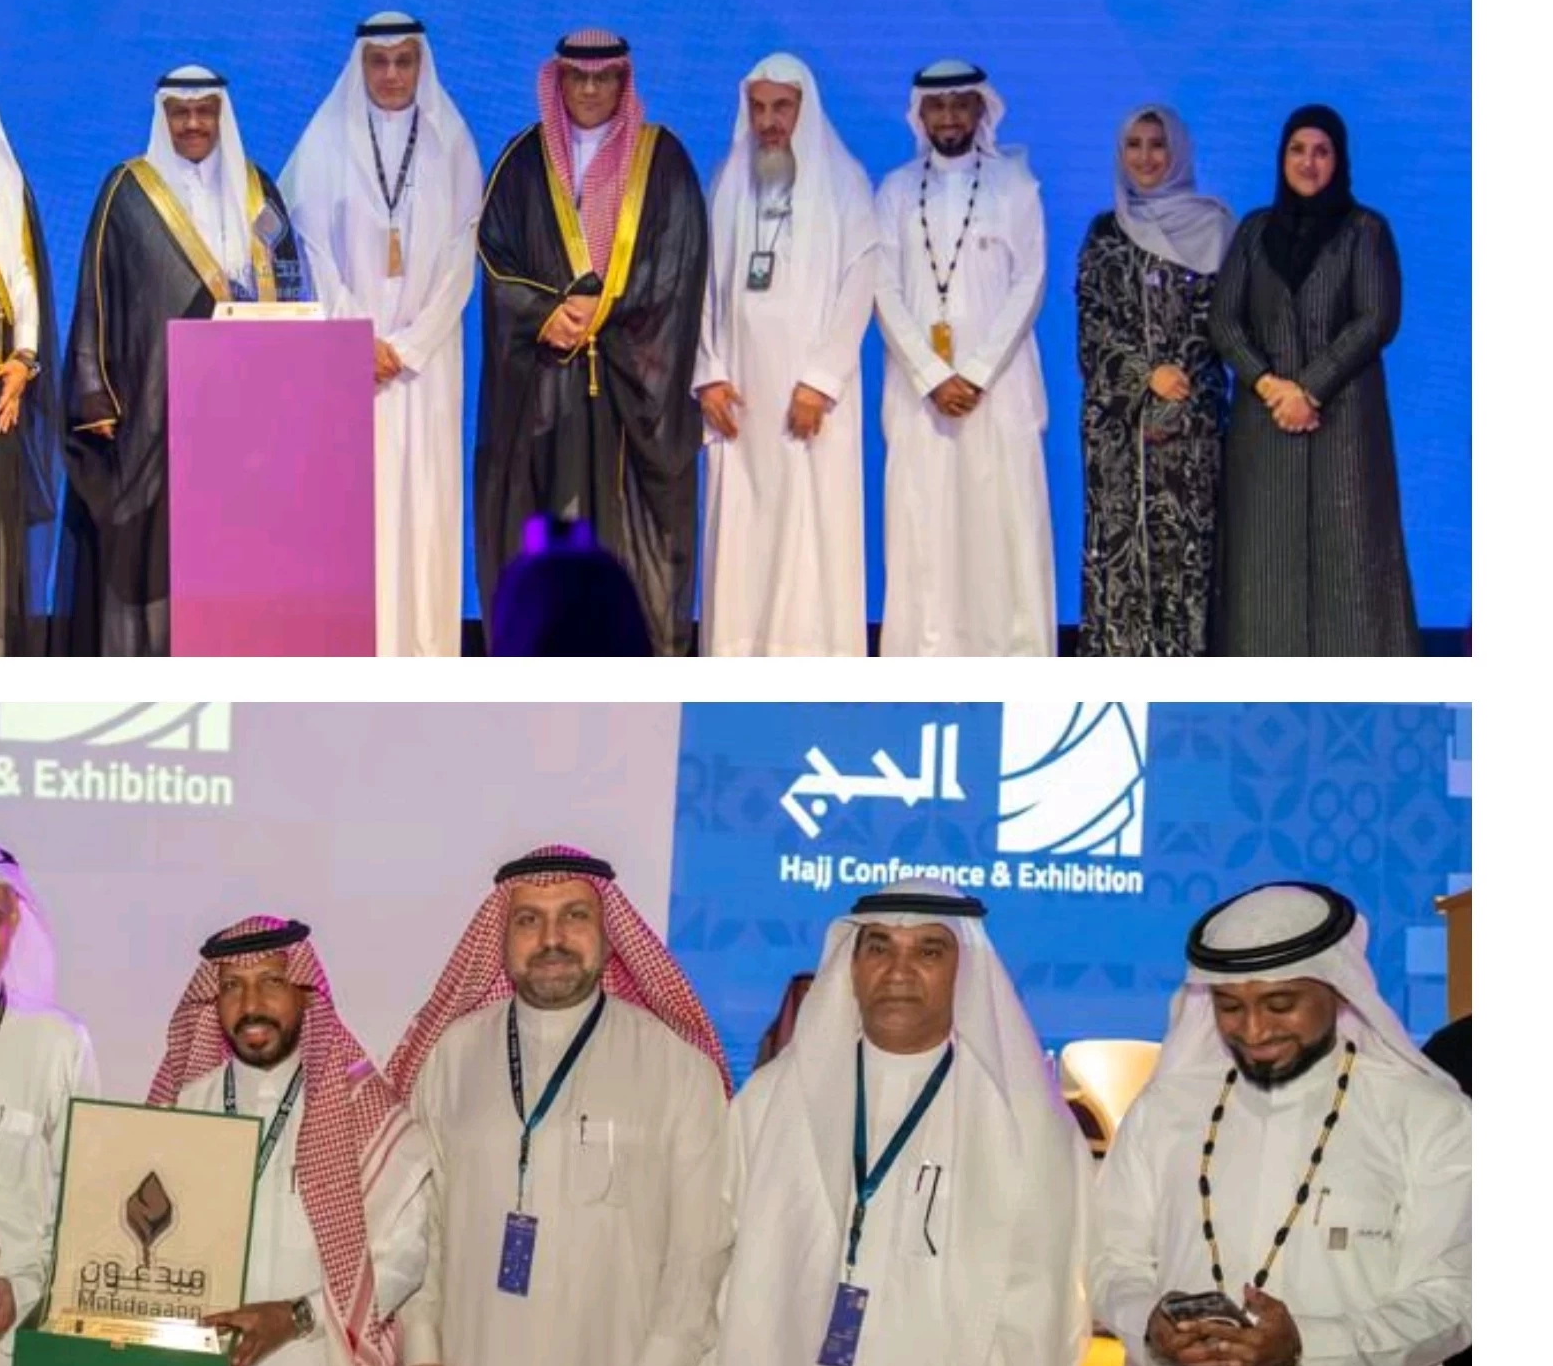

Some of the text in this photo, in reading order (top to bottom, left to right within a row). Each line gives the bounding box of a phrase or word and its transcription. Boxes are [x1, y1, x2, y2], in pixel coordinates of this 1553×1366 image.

[34, 757, 233, 805] Exhibition
[780, 723, 966, 839] الحج
[780, 855, 1143, 893] Hajj Conference & Exhibition
